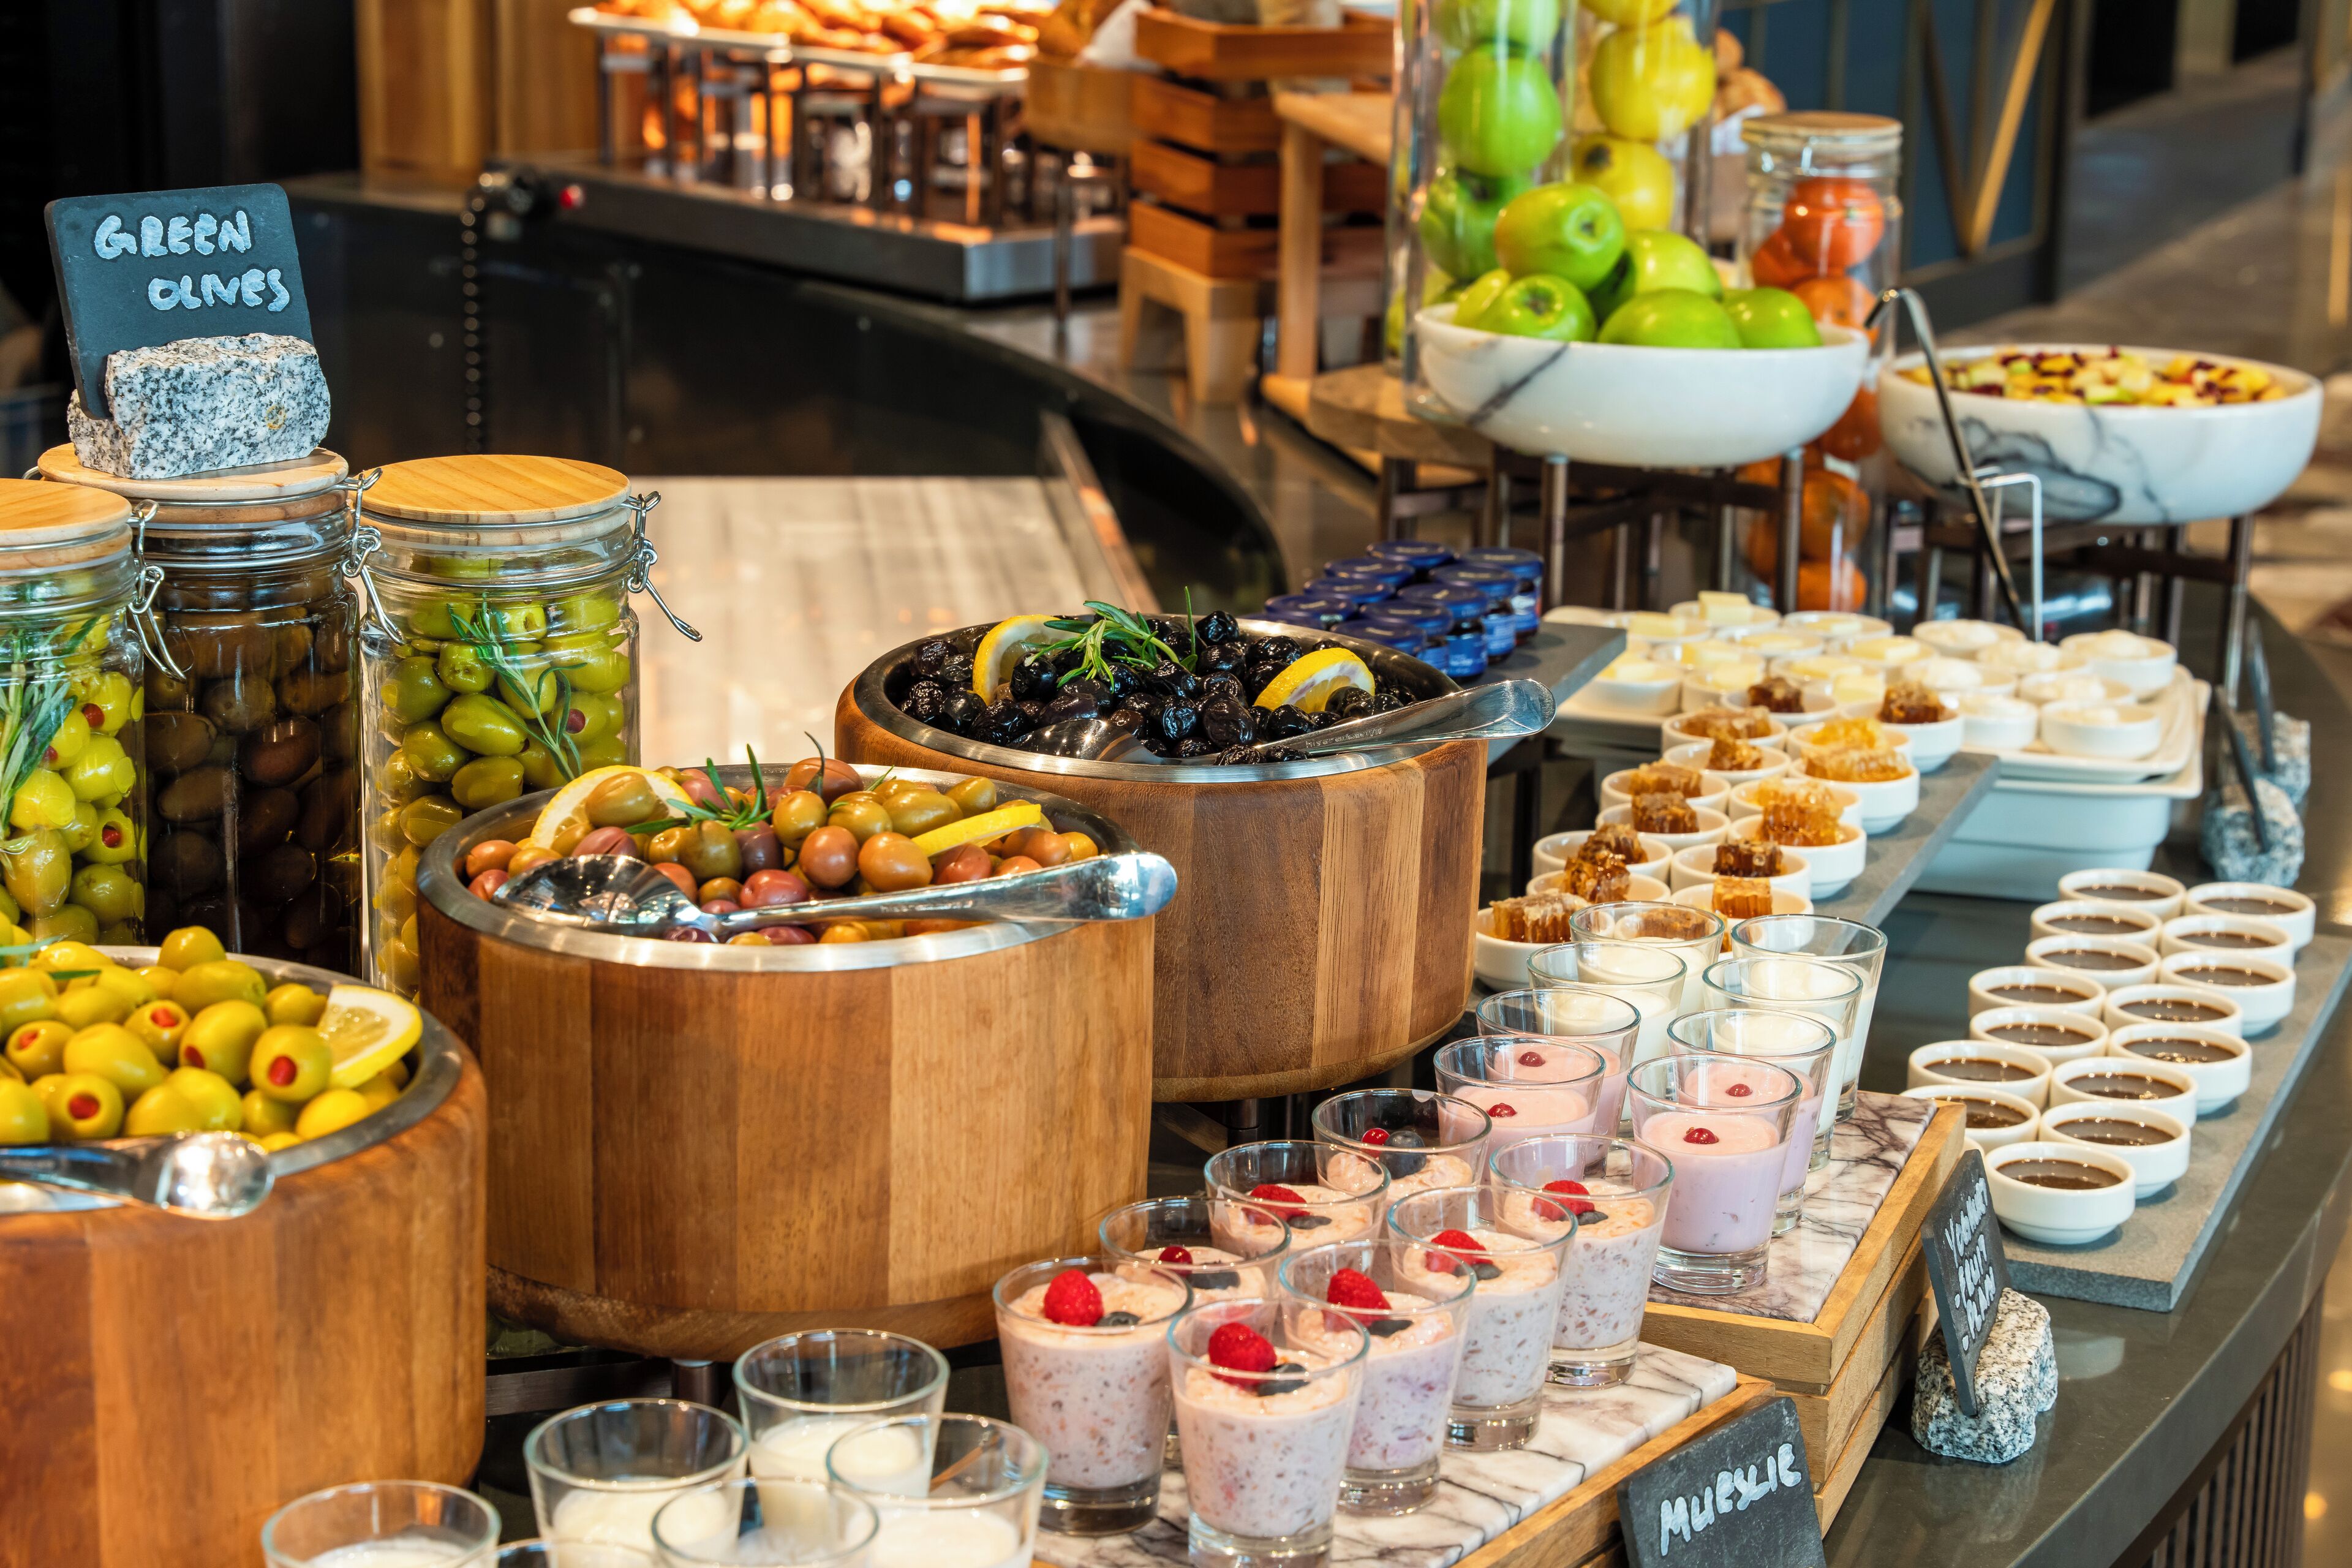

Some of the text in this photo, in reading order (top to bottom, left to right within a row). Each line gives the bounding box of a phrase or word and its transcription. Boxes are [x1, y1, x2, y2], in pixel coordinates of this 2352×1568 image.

[94, 210, 252, 260] GREEN
[148, 268, 290, 312] OLIVES
[1660, 1442, 1802, 1557] MUESLIE
